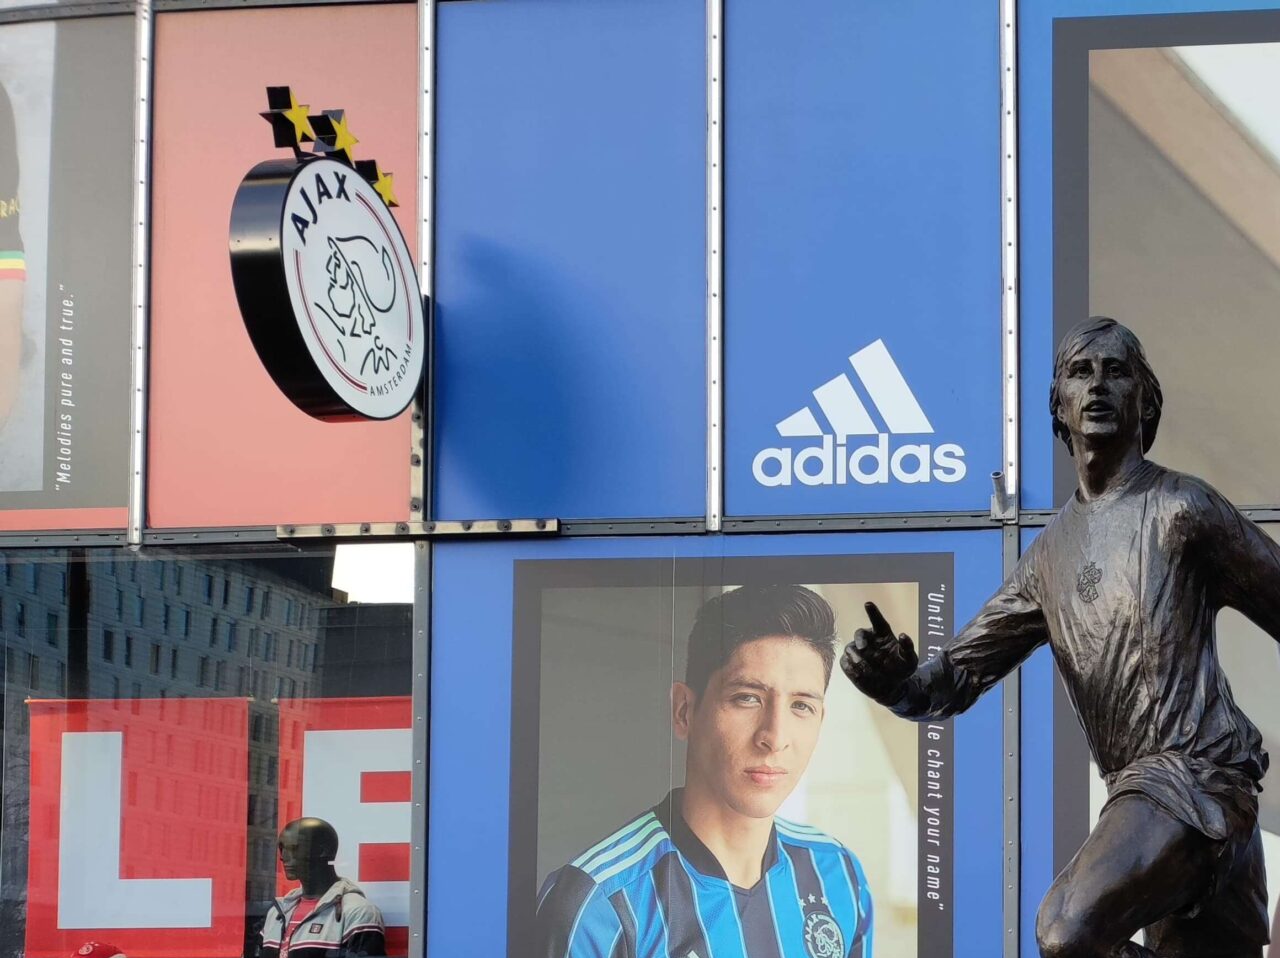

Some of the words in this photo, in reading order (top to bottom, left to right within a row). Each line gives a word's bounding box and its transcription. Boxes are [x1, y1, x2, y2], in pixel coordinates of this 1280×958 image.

[292, 171, 351, 246] AJAX
[59, 284, 76, 330] true."
[59, 338, 73, 365] and
[369, 344, 414, 397] AMSTERDAM
[60, 372, 75, 407] pure
[55, 414, 73, 491] "Melodies
[752, 433, 967, 487] adidas
[927, 749, 945, 799] chant
[923, 806, 940, 846] your
